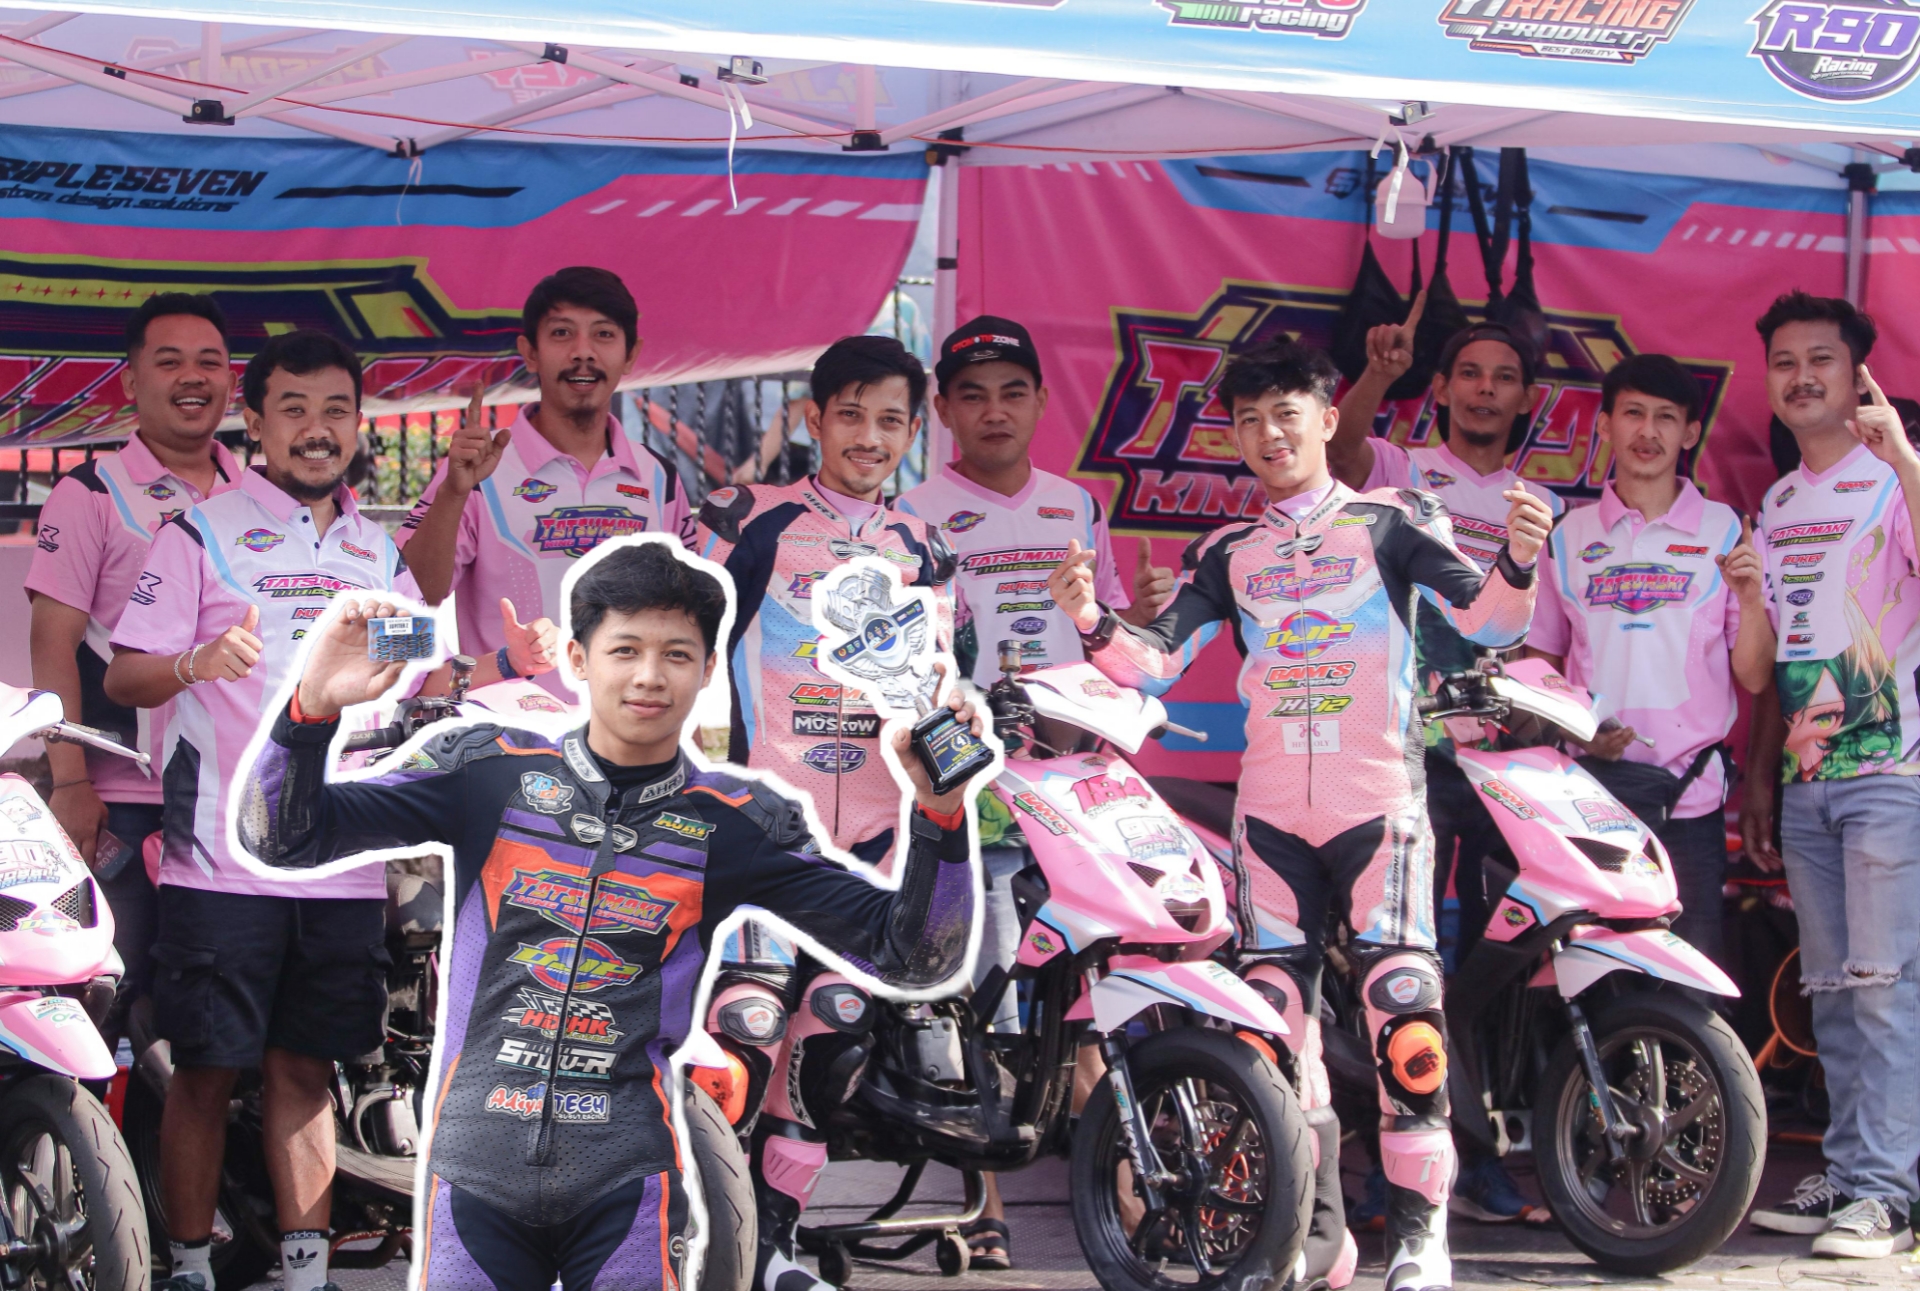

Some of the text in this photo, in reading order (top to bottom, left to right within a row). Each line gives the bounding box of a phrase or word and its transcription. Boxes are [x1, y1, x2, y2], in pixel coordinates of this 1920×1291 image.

[1239, 7, 1350, 32] racing
[1502, 0, 1684, 31] RACING
[1490, 20, 1644, 46] PRODUCT
[1540, 45, 1615, 58] BEST QUALITY
[1813, 56, 1878, 76] Racing
[55, 190, 133, 211] design
[133, 196, 240, 213] solutions
[513, 484, 557, 498] DJP
[541, 517, 644, 540] TATSUMAKI
[780, 533, 824, 544] NUKEY
[1770, 523, 1848, 541] TATSUMAKI
[1665, 543, 1710, 554] BAM'S
[1782, 553, 1825, 564] NUKEY
[265, 576, 364, 592] TATSUMA
[1592, 573, 1688, 595] TATSUMAKI
[1265, 624, 1356, 648] DJP
[1268, 663, 1354, 682] BAM'S
[1297, 677, 1347, 688] racing
[514, 877, 667, 920] TATSUMAKI
[516, 895, 557, 911] KING
[597, 909, 658, 929] SPRING
[512, 945, 640, 979] DJP
[284, 1230, 321, 1241] adidas
